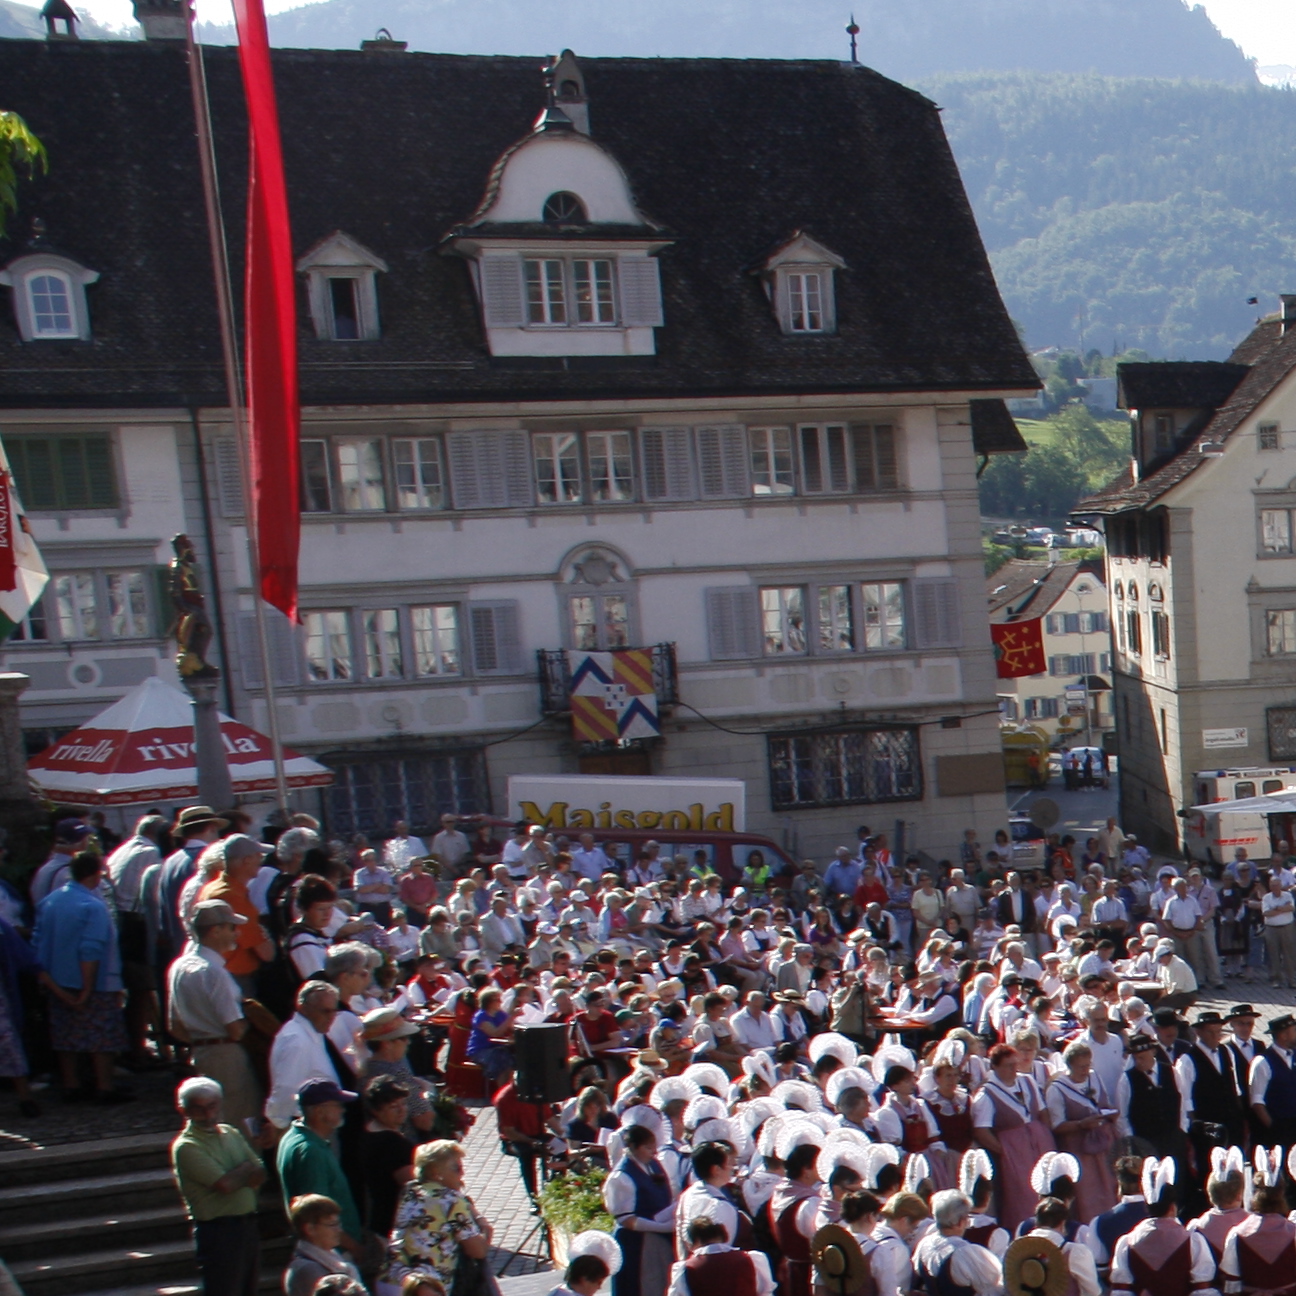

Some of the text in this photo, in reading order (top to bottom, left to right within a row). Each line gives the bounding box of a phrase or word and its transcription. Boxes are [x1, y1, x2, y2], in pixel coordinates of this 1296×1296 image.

[49, 738, 114, 763] rivella
[137, 733, 260, 761] rivla
[519, 801, 734, 832] Maisgold
